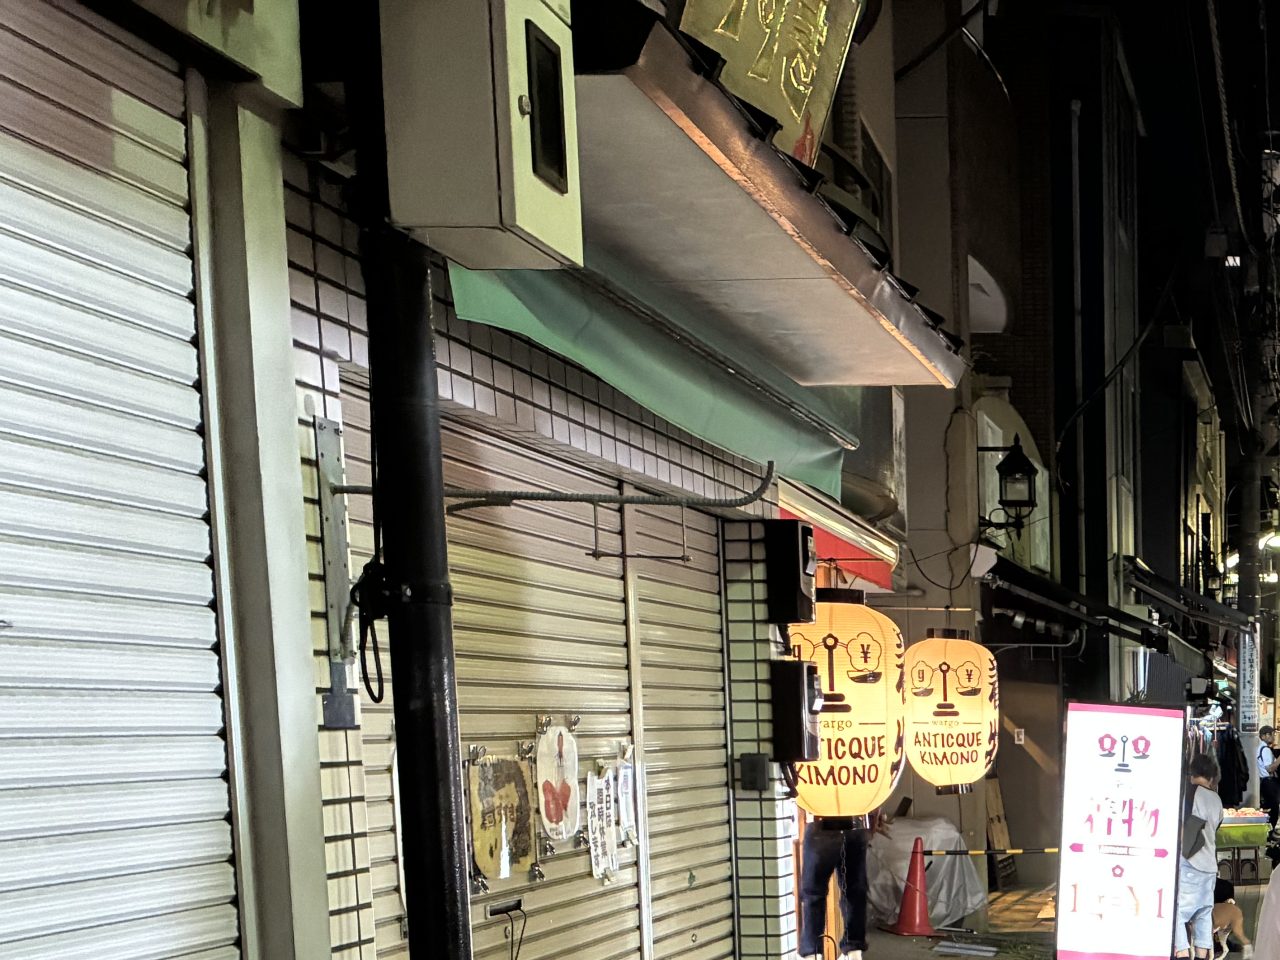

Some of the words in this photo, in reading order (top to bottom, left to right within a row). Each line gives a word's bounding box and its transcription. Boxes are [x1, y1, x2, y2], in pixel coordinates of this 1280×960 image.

[821, 735, 886, 760] ICQUE
[914, 731, 983, 749] ANTICQUE
[919, 750, 979, 766] KIMONO
[796, 763, 879, 786] KIMONO
